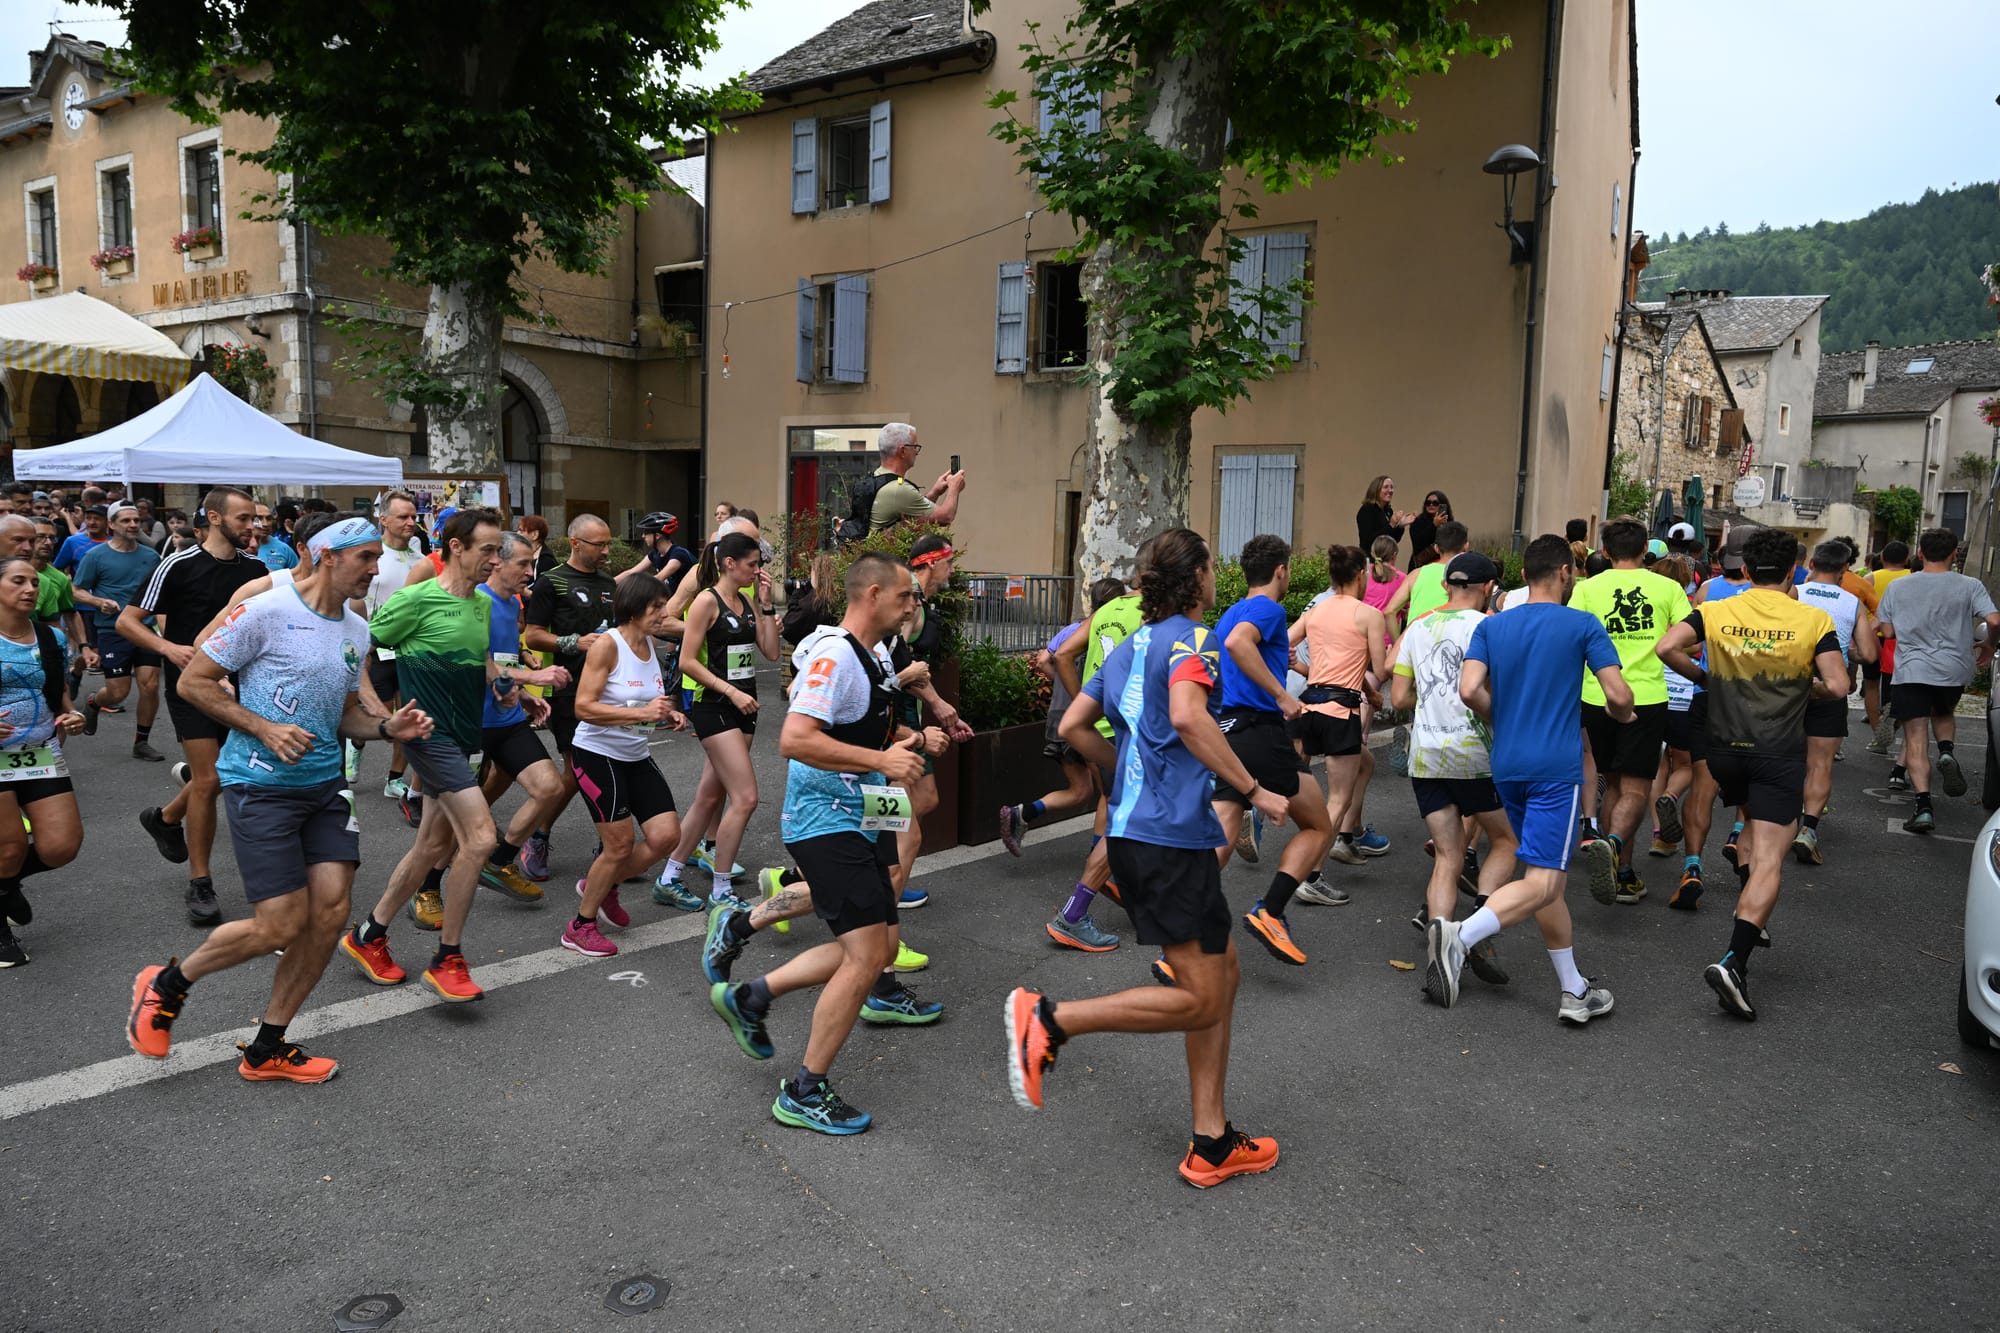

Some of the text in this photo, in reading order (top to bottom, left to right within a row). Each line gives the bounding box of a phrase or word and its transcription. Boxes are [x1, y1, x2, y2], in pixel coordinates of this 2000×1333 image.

[152, 269, 248, 306] MAIRIE
[1739, 442, 1752, 474] TABAC
[1720, 625, 1796, 641] CHOUFFE
[1743, 638, 1776, 650] Trail
[738, 653, 752, 668] 22
[8, 751, 37, 768] 33
[877, 796, 899, 816] 32
